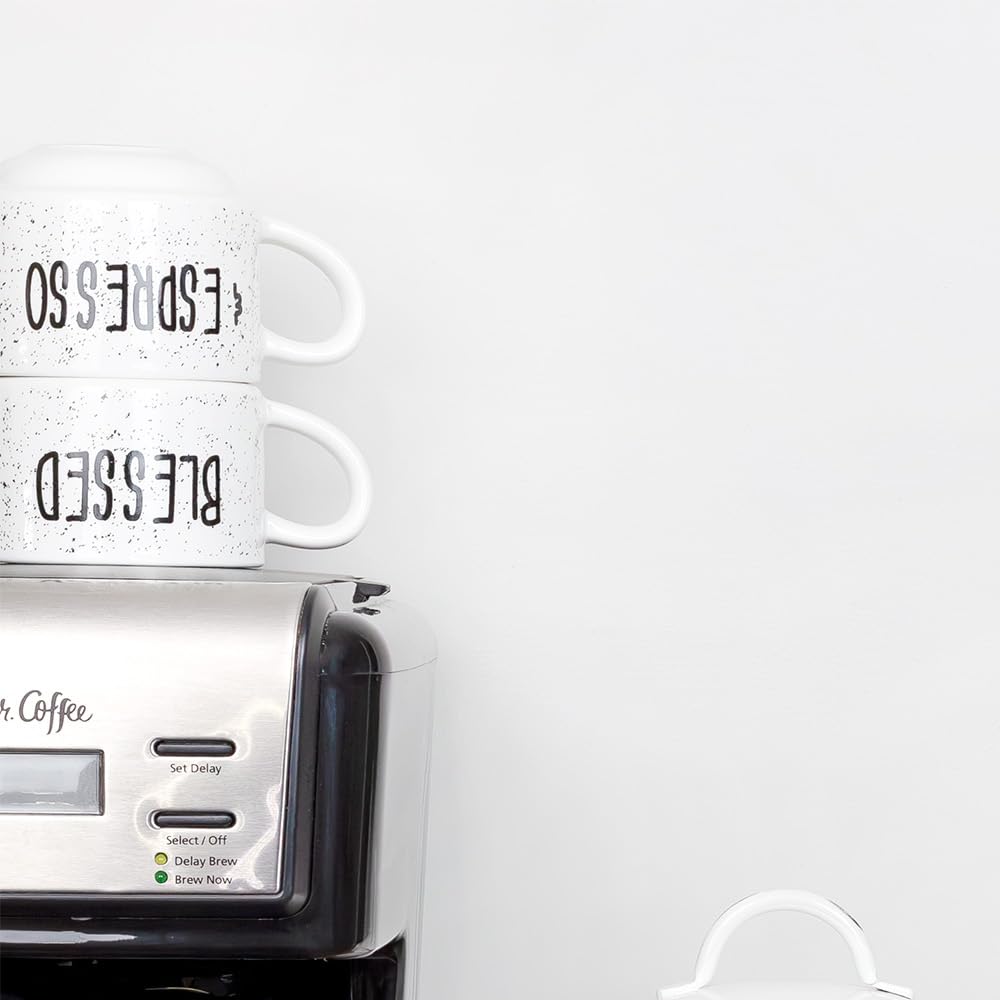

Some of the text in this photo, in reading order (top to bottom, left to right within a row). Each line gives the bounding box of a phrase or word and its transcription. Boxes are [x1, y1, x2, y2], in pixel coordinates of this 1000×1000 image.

[25, 260, 221, 335] ESPRESSO
[36, 449, 221, 527] BLESSED
[0, 689, 93, 735] r. Coffee
[170, 763, 222, 775] Set Delay
[166, 835, 199, 846] Select
[208, 835, 227, 846] Off
[174, 856, 238, 869] Delay Brew
[175, 874, 233, 885] Brew Now
